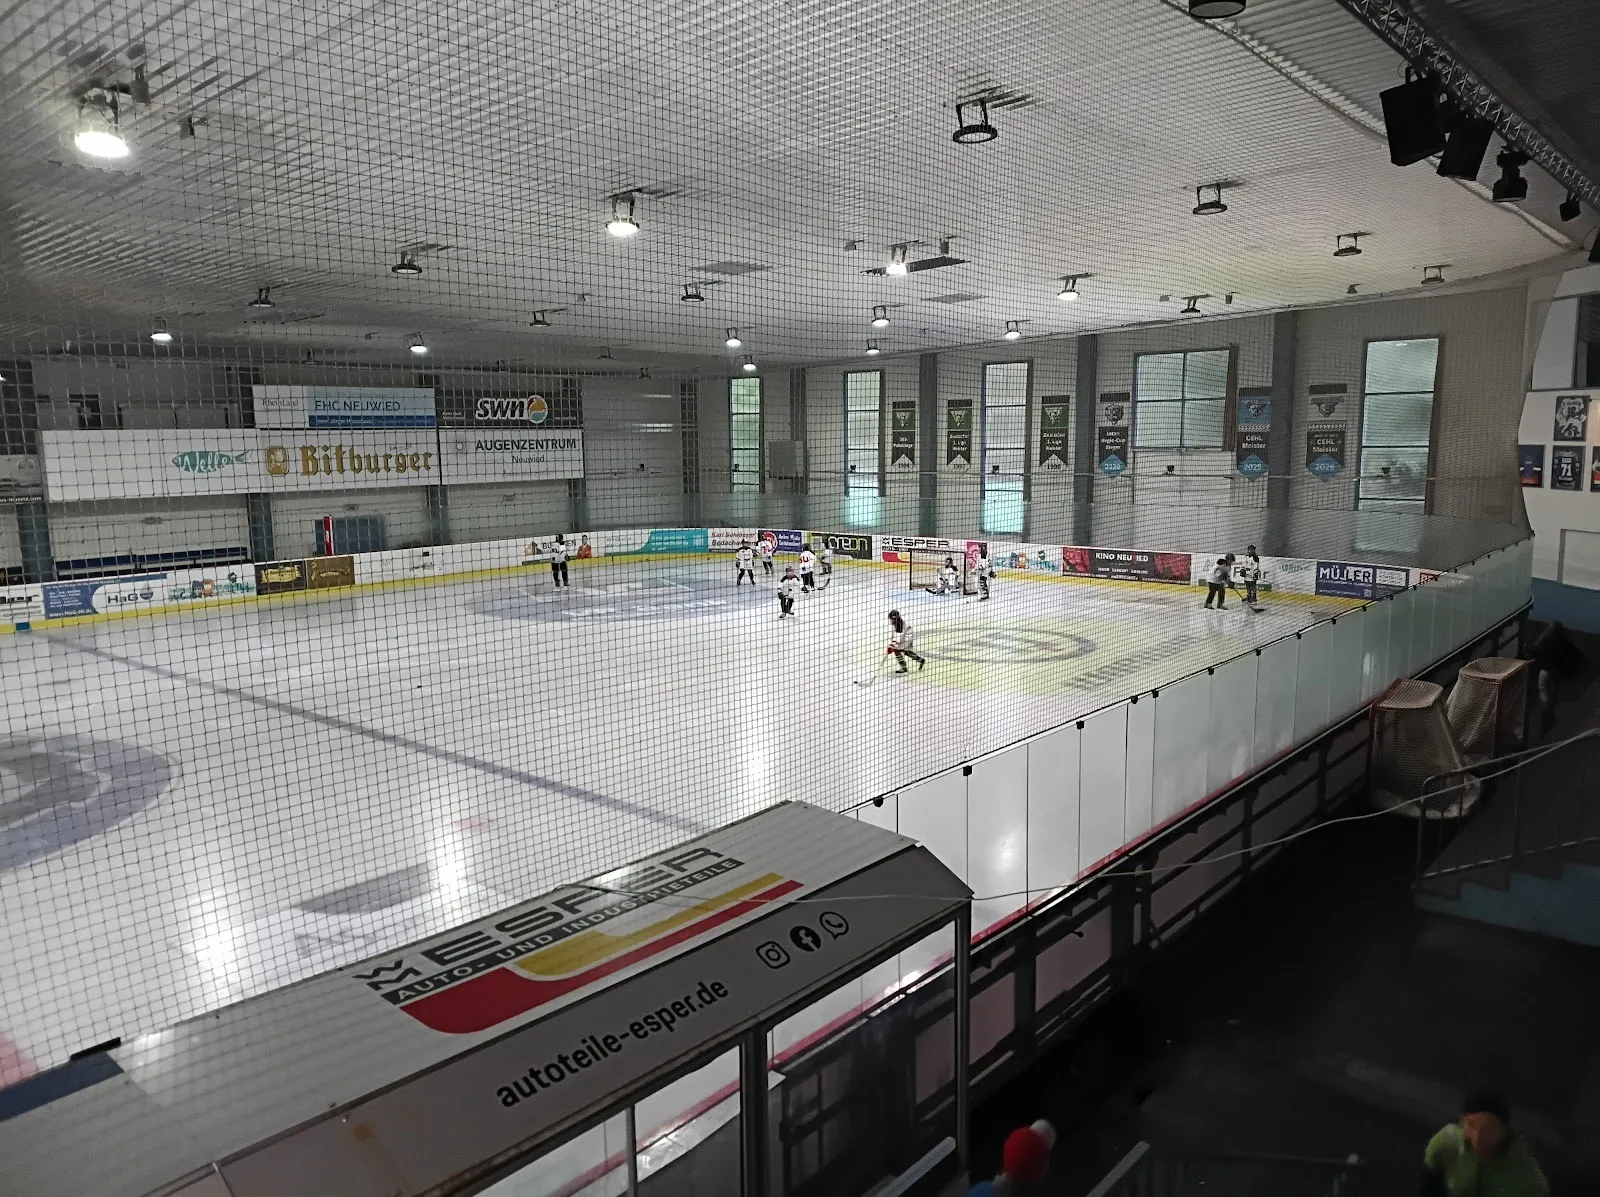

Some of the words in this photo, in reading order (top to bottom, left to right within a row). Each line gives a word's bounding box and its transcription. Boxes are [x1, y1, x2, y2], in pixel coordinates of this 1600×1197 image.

[315, 400, 341, 412] EHC
[343, 400, 401, 412] NEUWIED
[475, 438, 577, 451] AUGENZENTRUM
[299, 442, 433, 477] Bitburger
[511, 454, 545, 464] Neuwied
[1243, 463, 1262, 471] 2025
[891, 538, 949, 549] ESPER
[1095, 552, 1115, 560] KINO
[1319, 564, 1374, 583] MÜLLER
[420, 846, 726, 967] ESPER
[397, 964, 486, 1004] AUTO-
[500, 929, 556, 959] UND
[562, 858, 738, 933] INDUSTRIETEILE
[496, 977, 729, 1109] autoteile-esper.de
